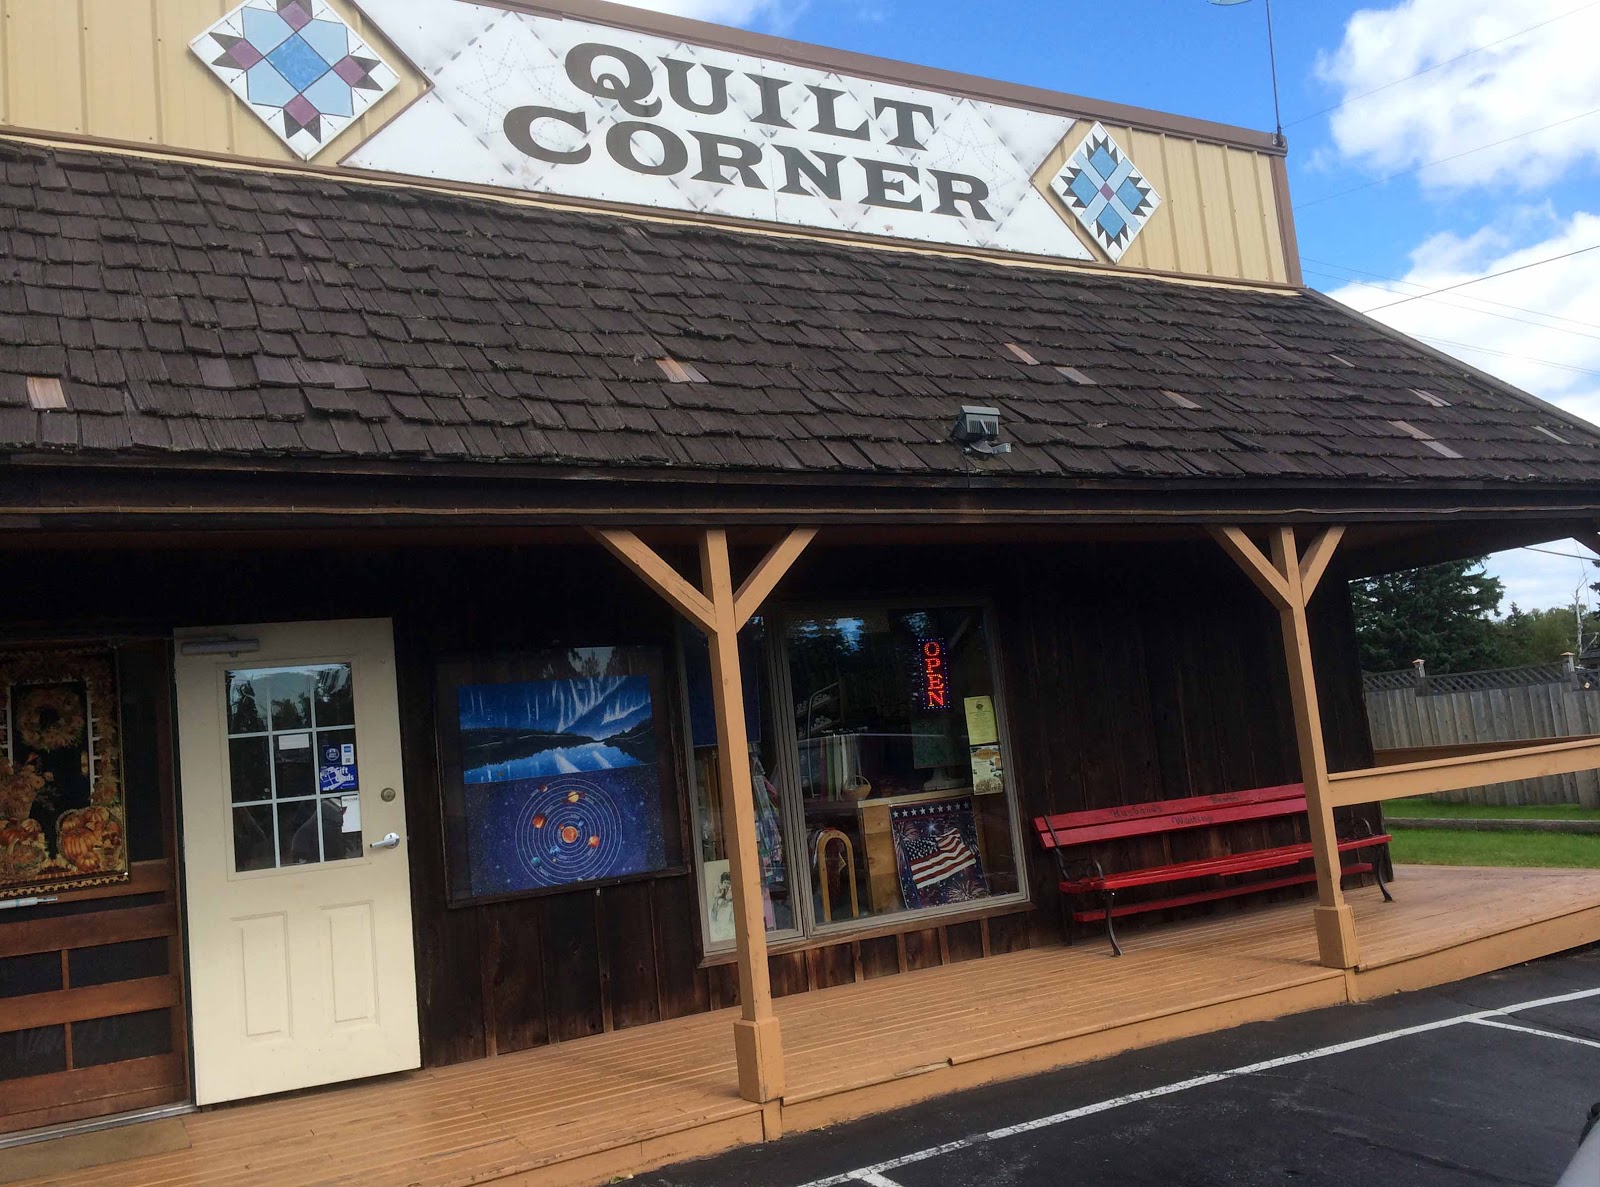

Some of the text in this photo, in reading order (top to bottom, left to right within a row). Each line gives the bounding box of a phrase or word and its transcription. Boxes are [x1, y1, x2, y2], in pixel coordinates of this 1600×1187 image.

[564, 42, 935, 151] QUILT
[502, 105, 994, 222] CORNER
[924, 641, 945, 707] OPEN
[1171, 814, 1214, 825] Waiting
